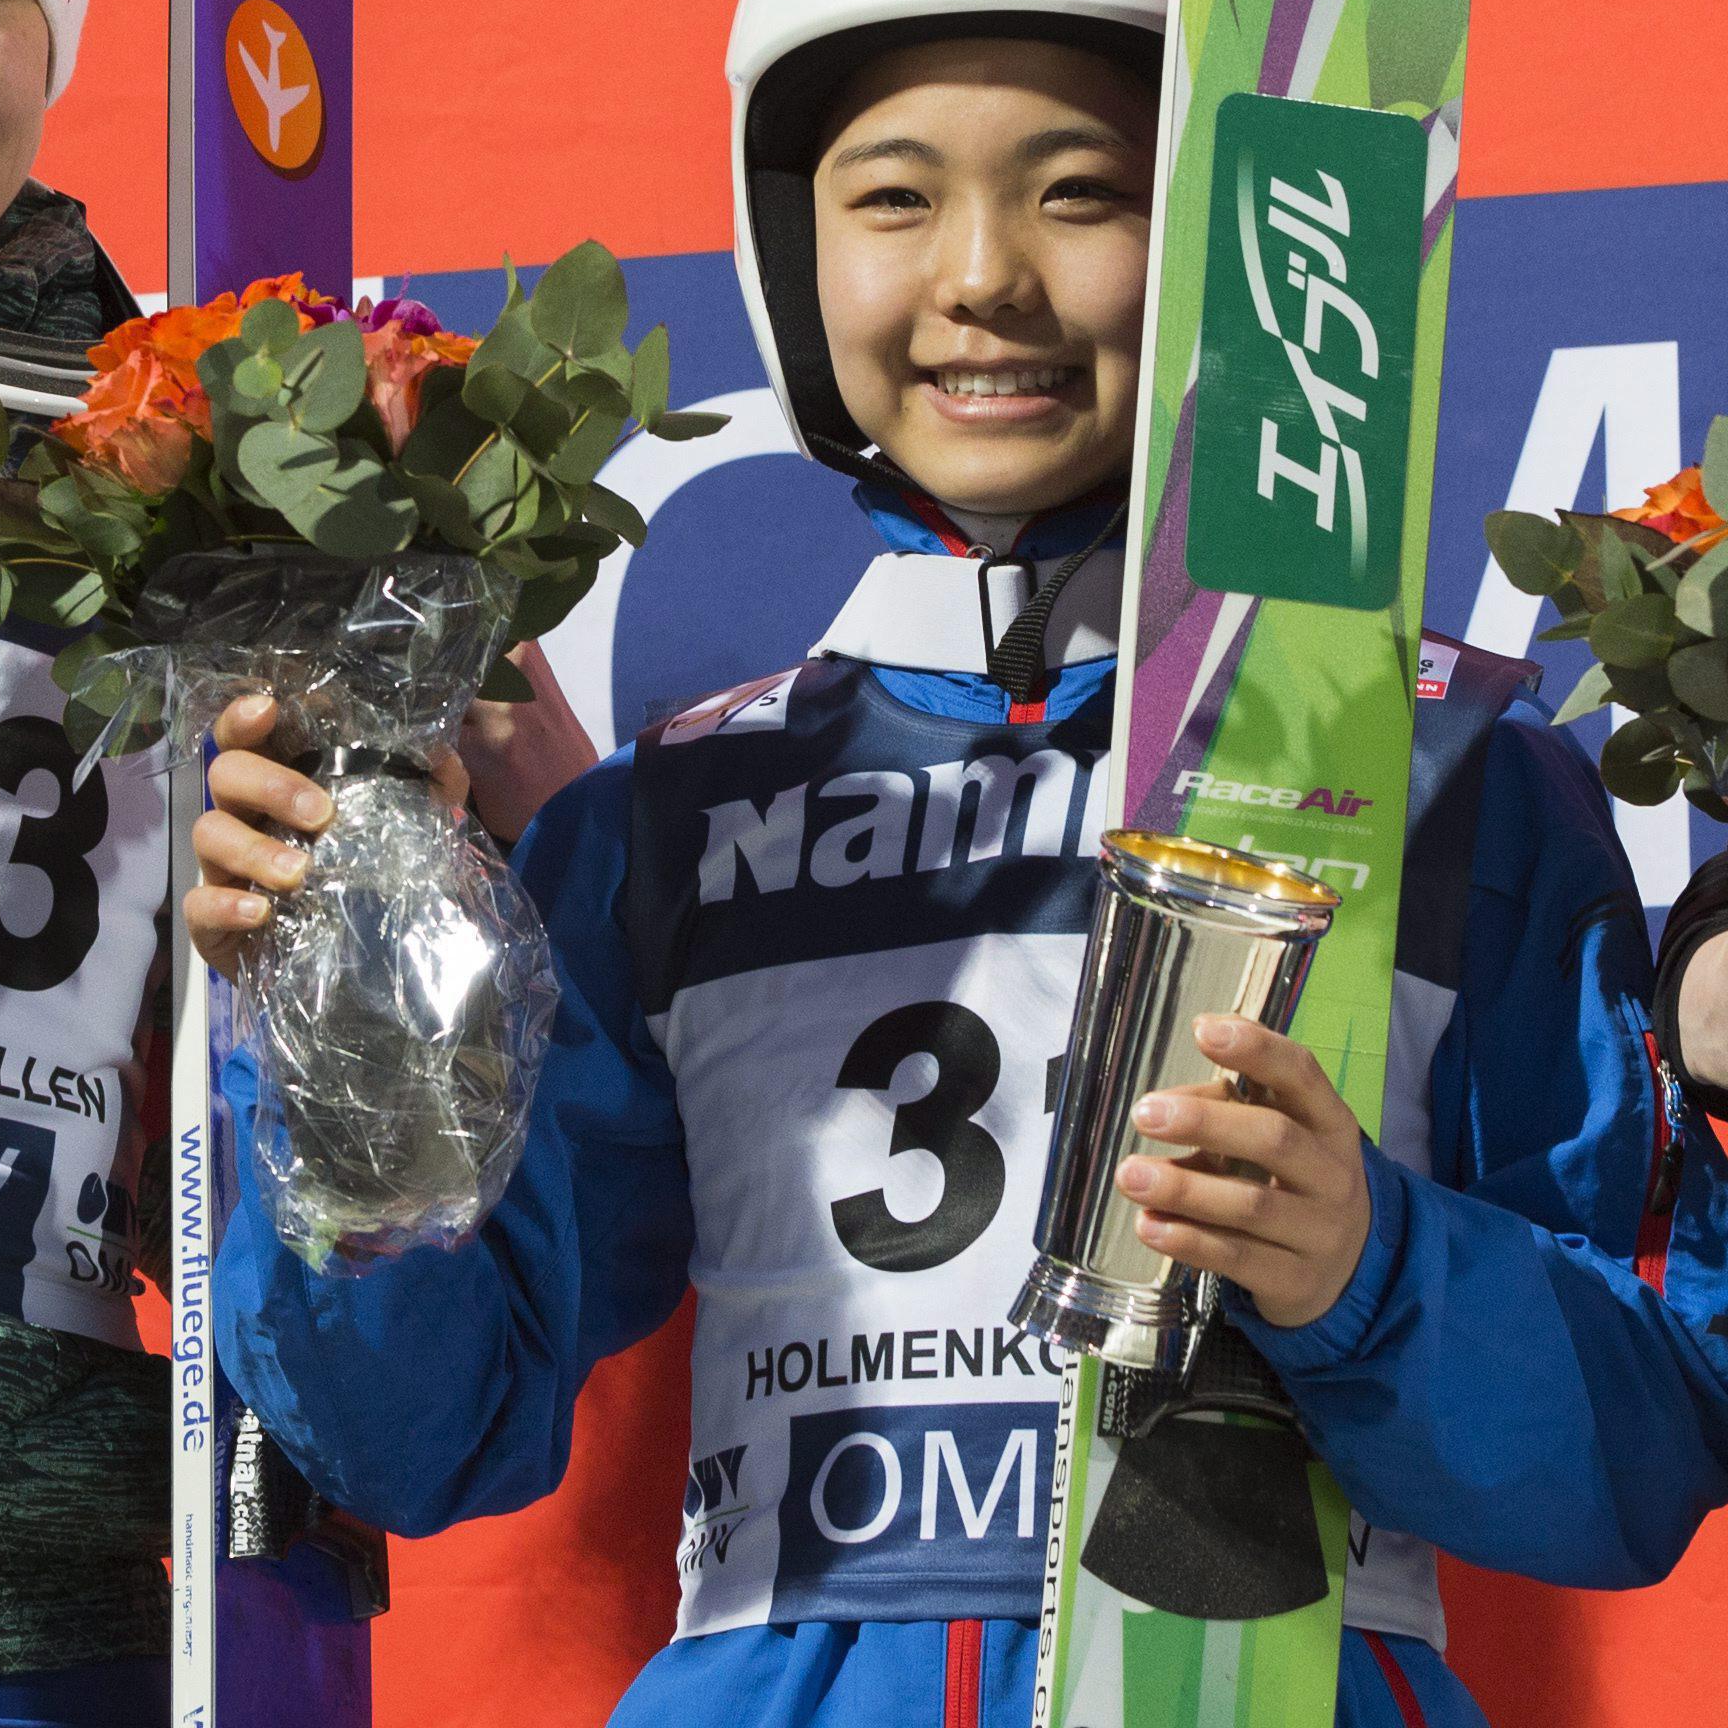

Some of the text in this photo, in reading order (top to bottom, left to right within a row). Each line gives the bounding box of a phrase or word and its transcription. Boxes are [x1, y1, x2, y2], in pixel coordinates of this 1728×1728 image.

[1257, 168, 1379, 533] エイブル
[698, 745, 1112, 904] Nam
[831, 1000, 1074, 1273] 3
[173, 1124, 210, 1454] www.fluege.de
[230, 1408, 263, 1552] atnar.com
[810, 1428, 1058, 1544] OM
